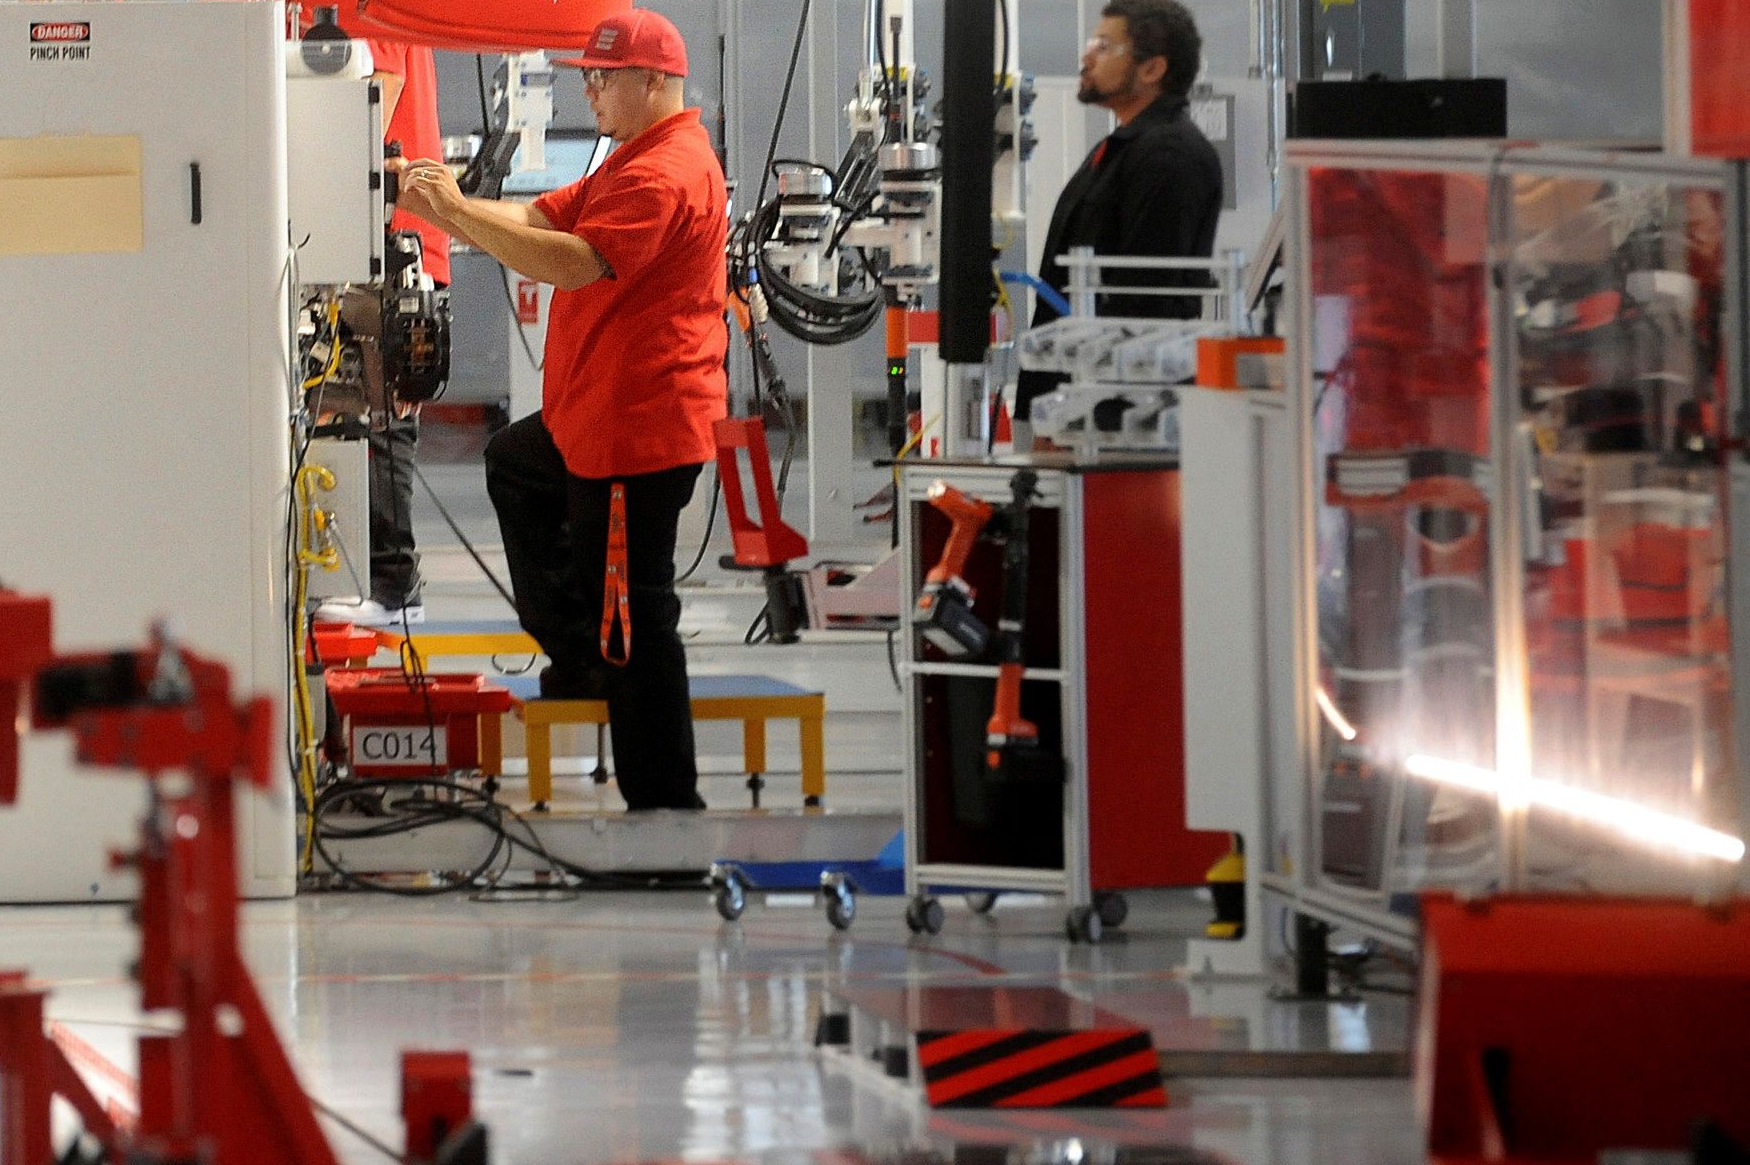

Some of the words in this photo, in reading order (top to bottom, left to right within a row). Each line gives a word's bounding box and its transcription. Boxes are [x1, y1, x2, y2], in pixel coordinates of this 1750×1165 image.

[37, 25, 83, 39] DANGER
[30, 46, 59, 60] PINCH
[62, 46, 90, 60] POINT
[362, 731, 436, 761] C014
